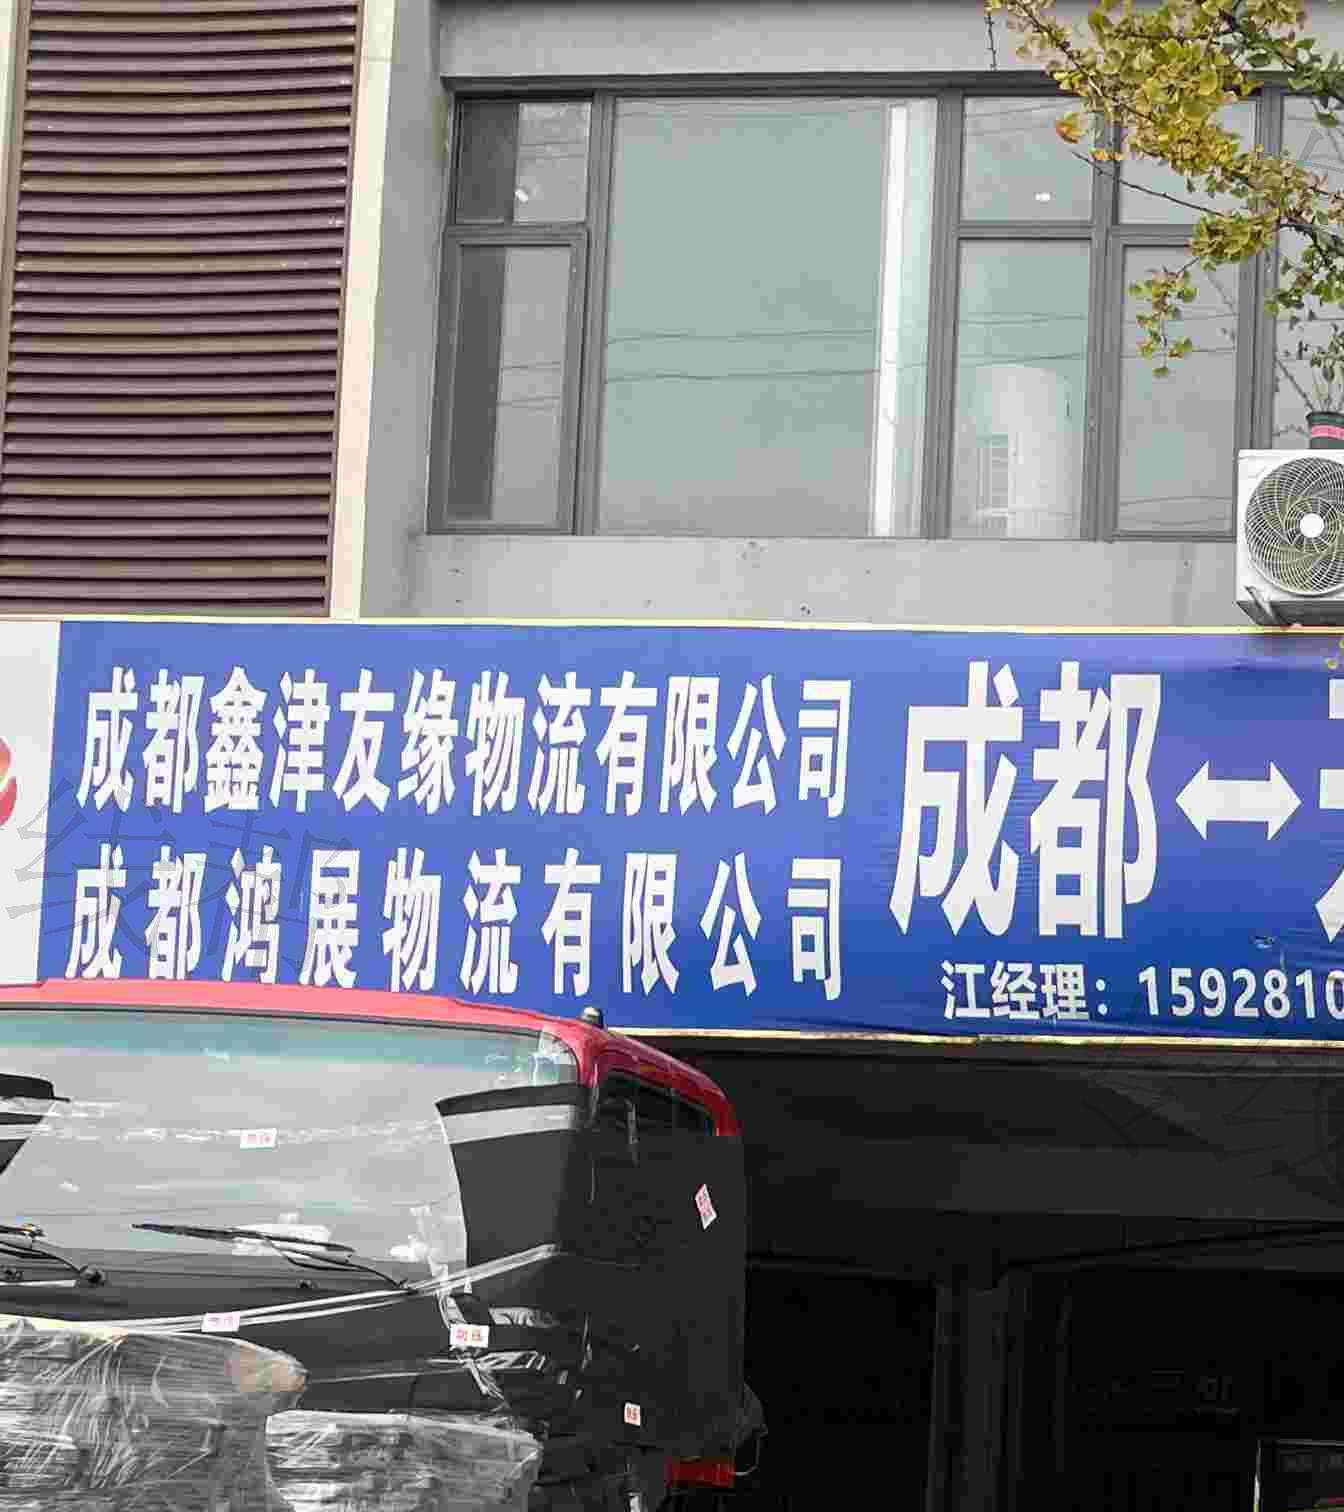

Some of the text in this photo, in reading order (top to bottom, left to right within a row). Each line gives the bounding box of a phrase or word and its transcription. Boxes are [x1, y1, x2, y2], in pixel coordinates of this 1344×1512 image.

[76, 666, 853, 818] 成都鑫津友缘物流有限公司
[889, 661, 1162, 939] 成都
[65, 844, 843, 1000] 成都鸿展物流有限公司
